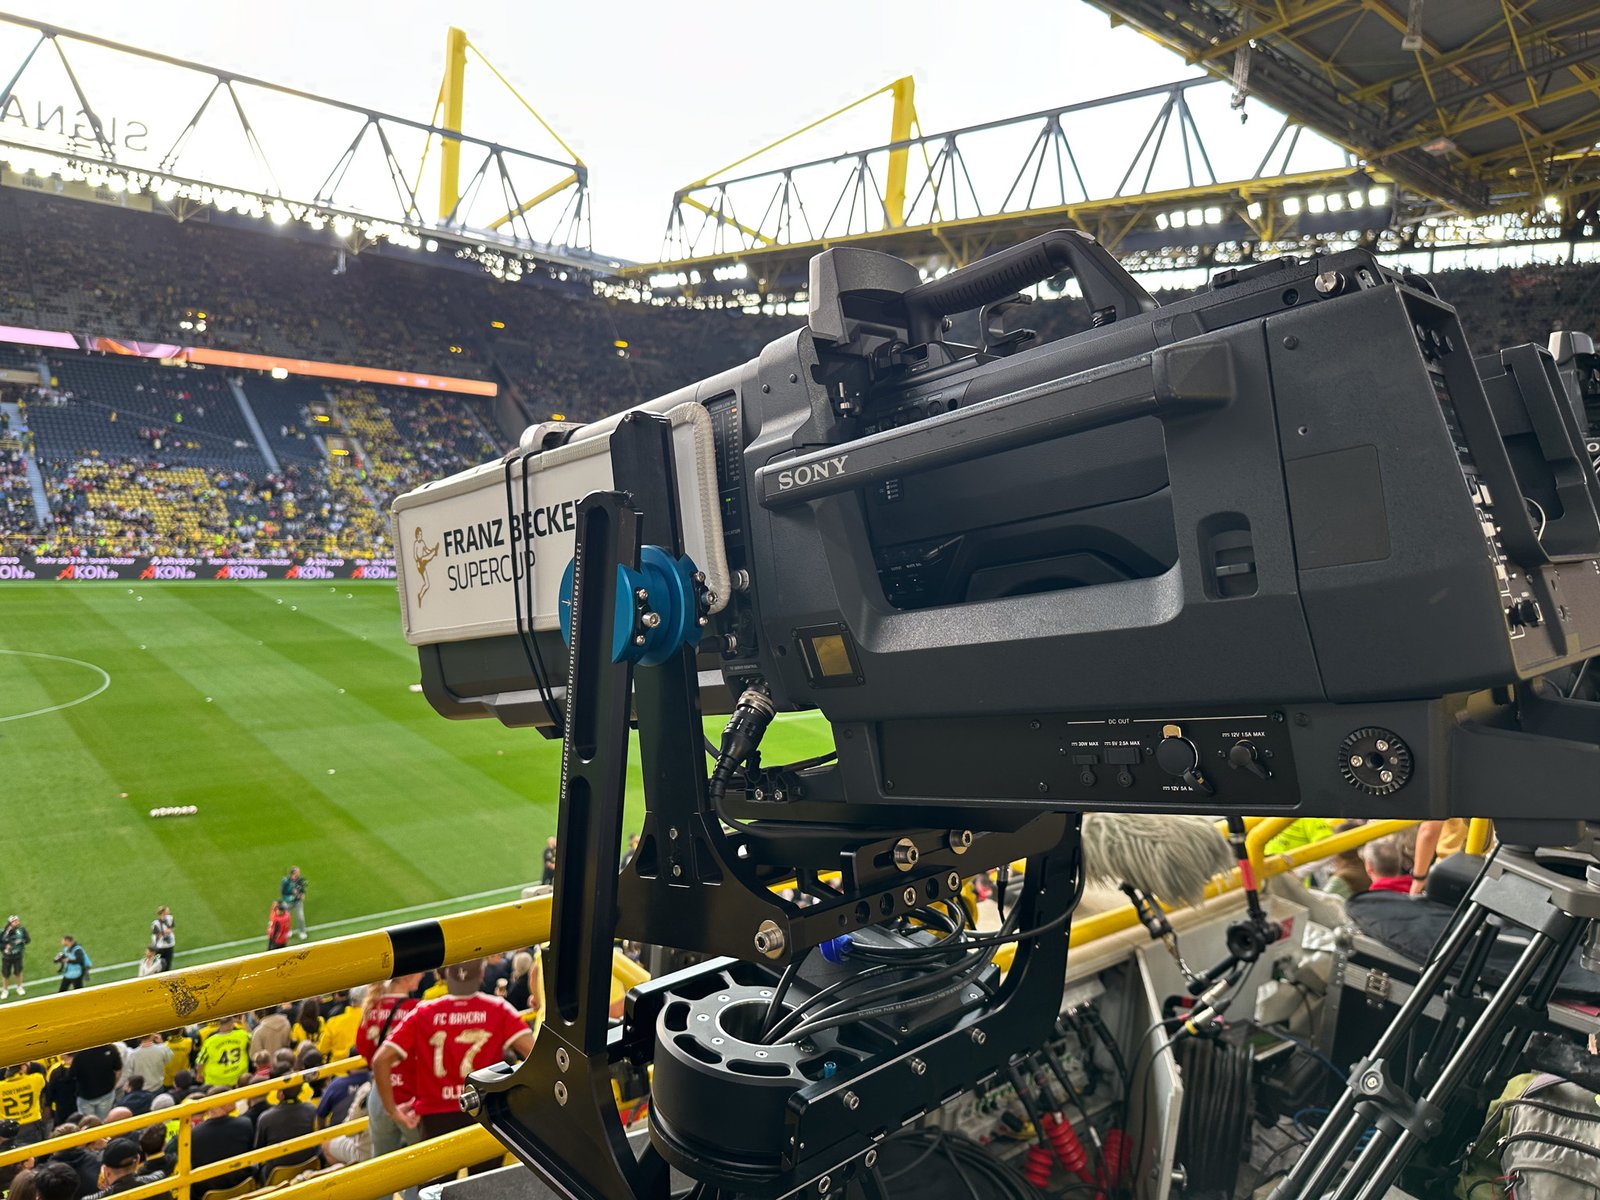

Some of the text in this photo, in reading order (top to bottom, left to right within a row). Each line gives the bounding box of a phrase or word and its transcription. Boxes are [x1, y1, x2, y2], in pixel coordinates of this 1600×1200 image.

[778, 455, 848, 490] SONY
[443, 499, 580, 557] FRANZ BECKE
[447, 550, 536, 592] SUPERCUP
[433, 1011, 486, 1026] FC BAYERN
[218, 1046, 241, 1066] 43
[429, 1028, 493, 1078] 17
[2, 1090, 34, 1116] 23
